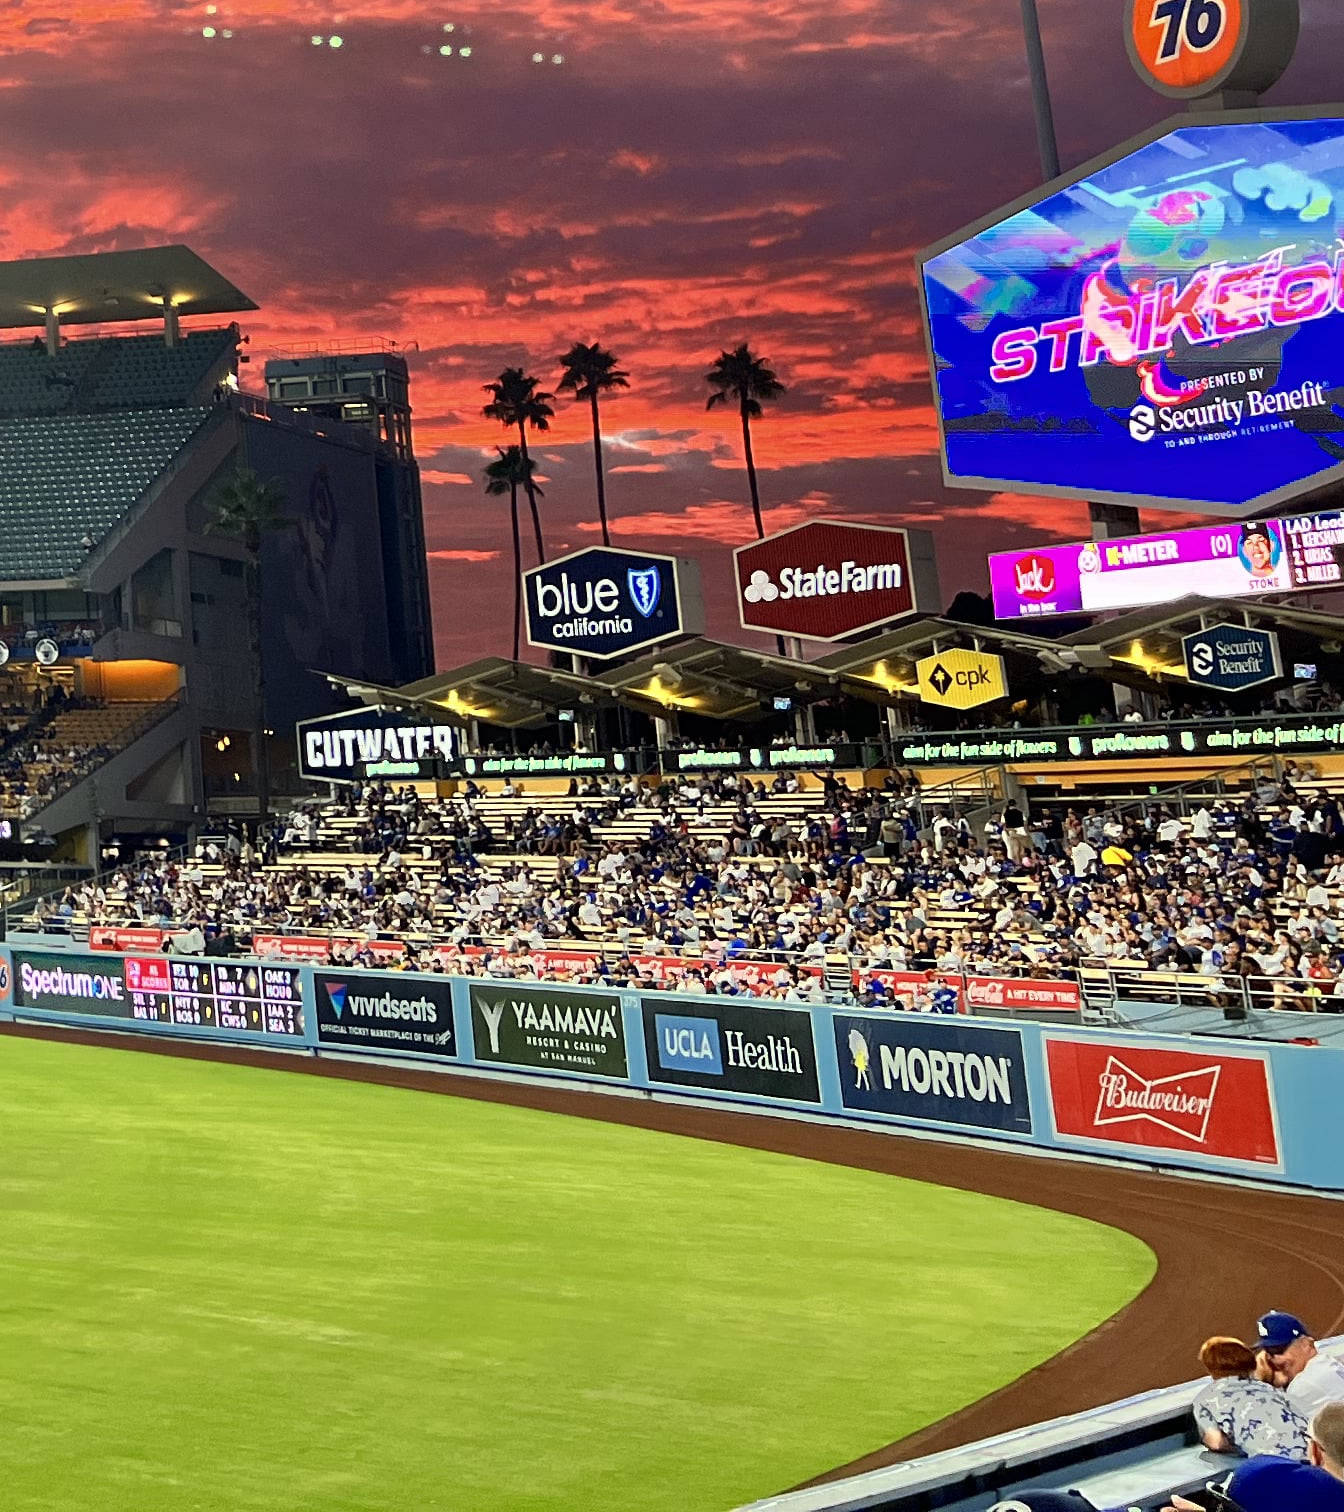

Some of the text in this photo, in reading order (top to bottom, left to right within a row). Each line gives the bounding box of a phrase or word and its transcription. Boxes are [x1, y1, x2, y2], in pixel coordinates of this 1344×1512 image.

[990, 243, 1344, 383] STRIKEO
[1180, 367, 1264, 392] PRESENTED BY
[1158, 380, 1326, 433] Security Benefit
[1164, 420, 1295, 448] TO AND THROUGH RETIREMENT
[1286, 517, 1311, 534] LAD
[1106, 534, 1232, 566] K-METER (0)
[1015, 559, 1054, 594] Jack
[1249, 577, 1279, 589] STONE
[536, 573, 619, 617] blue
[552, 615, 633, 639] california
[1217, 640, 1263, 660] Security
[1219, 657, 1262, 675] Benefit
[956, 664, 991, 691] cpk
[1207, 725, 1324, 748] aim for the fun side
[306, 726, 454, 768] CUTWATER
[942, 744, 960, 758] the
[189, 965, 199, 978] 10
[236, 968, 243, 981] 7
[265, 969, 291, 984] OAK 3
[173, 978, 198, 991] TOR 4
[219, 981, 244, 995] MIN 4
[266, 985, 292, 999] HOU 0
[193, 998, 199, 1011] 0
[221, 1001, 246, 1015] KC 0
[287, 1005, 294, 1019] 2
[348, 992, 437, 1024] vividseats
[176, 1010, 200, 1025] BOS 0
[222, 1014, 247, 1029] CWS 0
[268, 1020, 294, 1034] SEA 3
[511, 998, 617, 1039] YAAMAVA'
[320, 1023, 434, 1043] OFFICIAL TICKET MARKETPLACE OF THE
[664, 1026, 713, 1060] UCLA
[526, 1036, 559, 1048] RESORT
[574, 1041, 607, 1054] CASINO
[725, 1029, 802, 1075] Health
[880, 1044, 1010, 1105] MORTON
[1099, 1071, 1212, 1116] Budweiser
